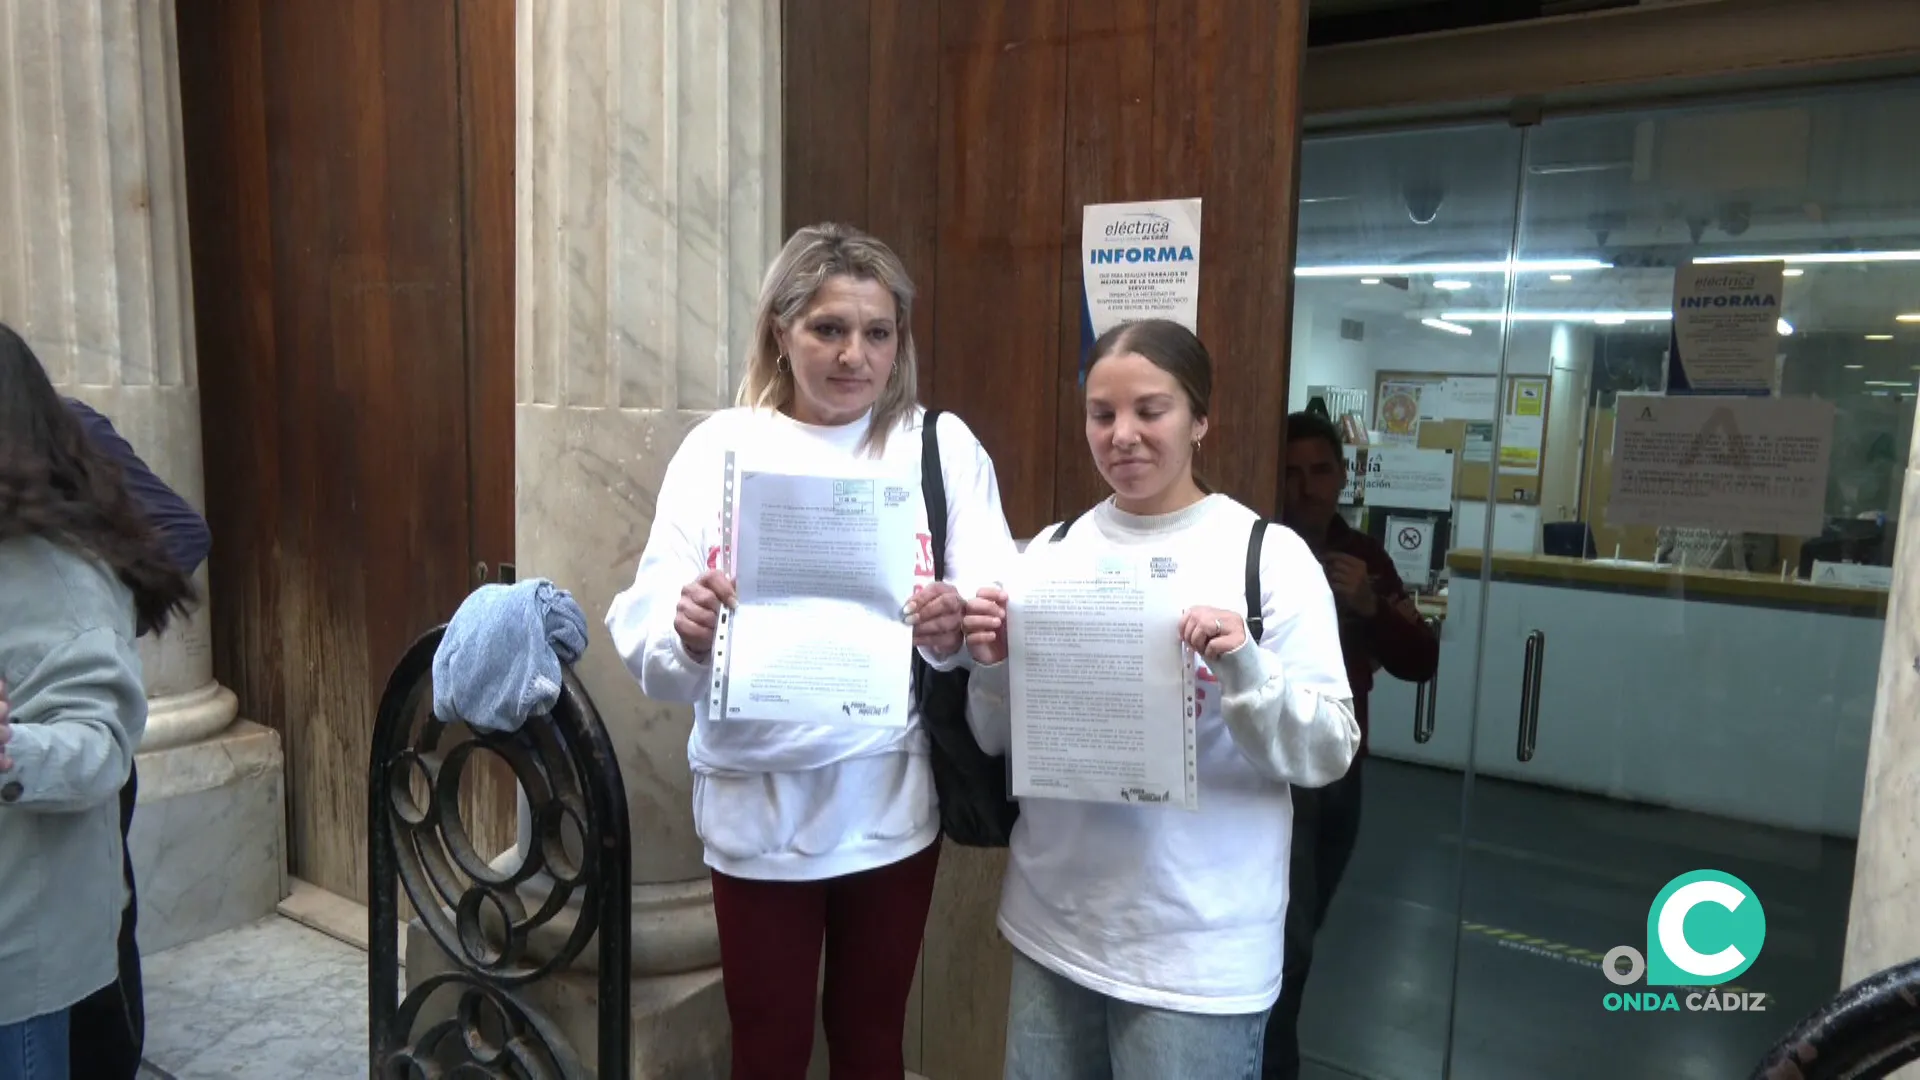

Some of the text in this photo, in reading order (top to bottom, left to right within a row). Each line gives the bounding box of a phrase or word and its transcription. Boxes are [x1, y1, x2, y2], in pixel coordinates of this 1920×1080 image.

[1105, 221, 1169, 236] eléctrica
[1090, 246, 1194, 264] INFORMA
[1681, 294, 1776, 308] INFORMA
